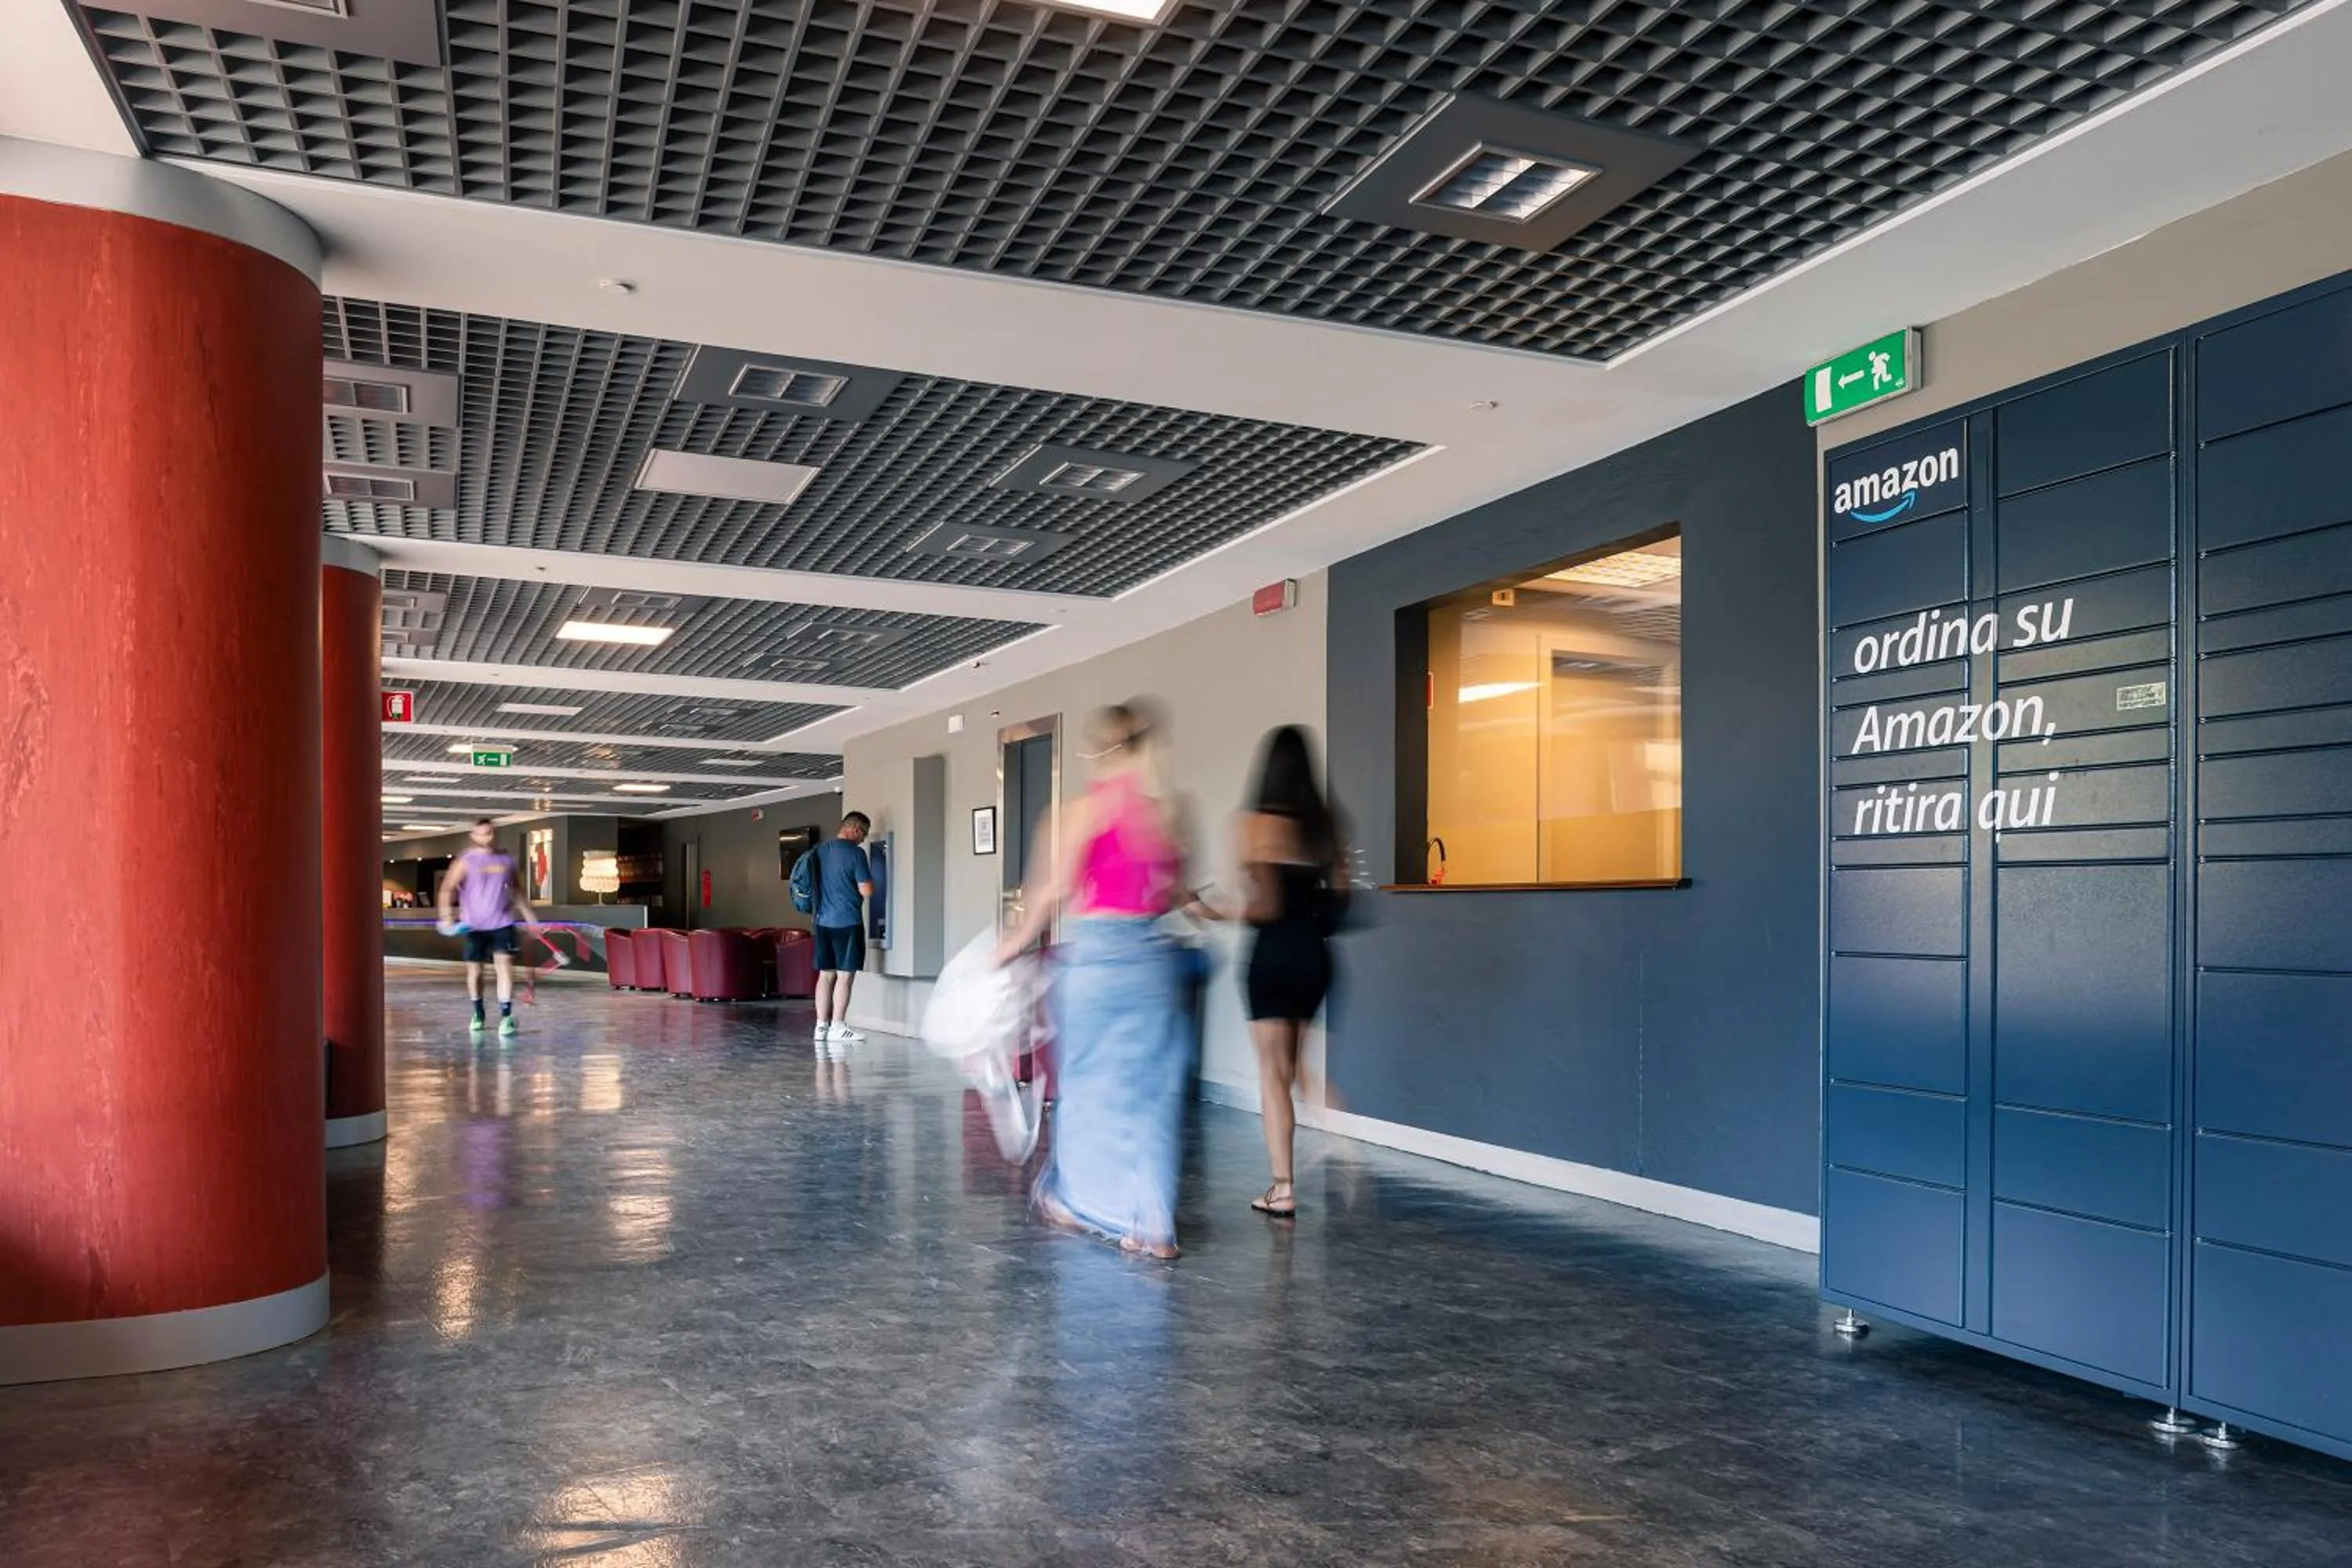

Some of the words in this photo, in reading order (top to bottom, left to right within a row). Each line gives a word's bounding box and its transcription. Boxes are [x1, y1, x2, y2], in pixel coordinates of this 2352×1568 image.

[1834, 447, 1958, 514] amazon
[1854, 609, 1998, 673] ordina
[2013, 598, 2074, 647] su
[1850, 695, 2056, 754] Amazon,
[1854, 782, 1960, 835] ritira
[1978, 771, 2060, 843] qui
